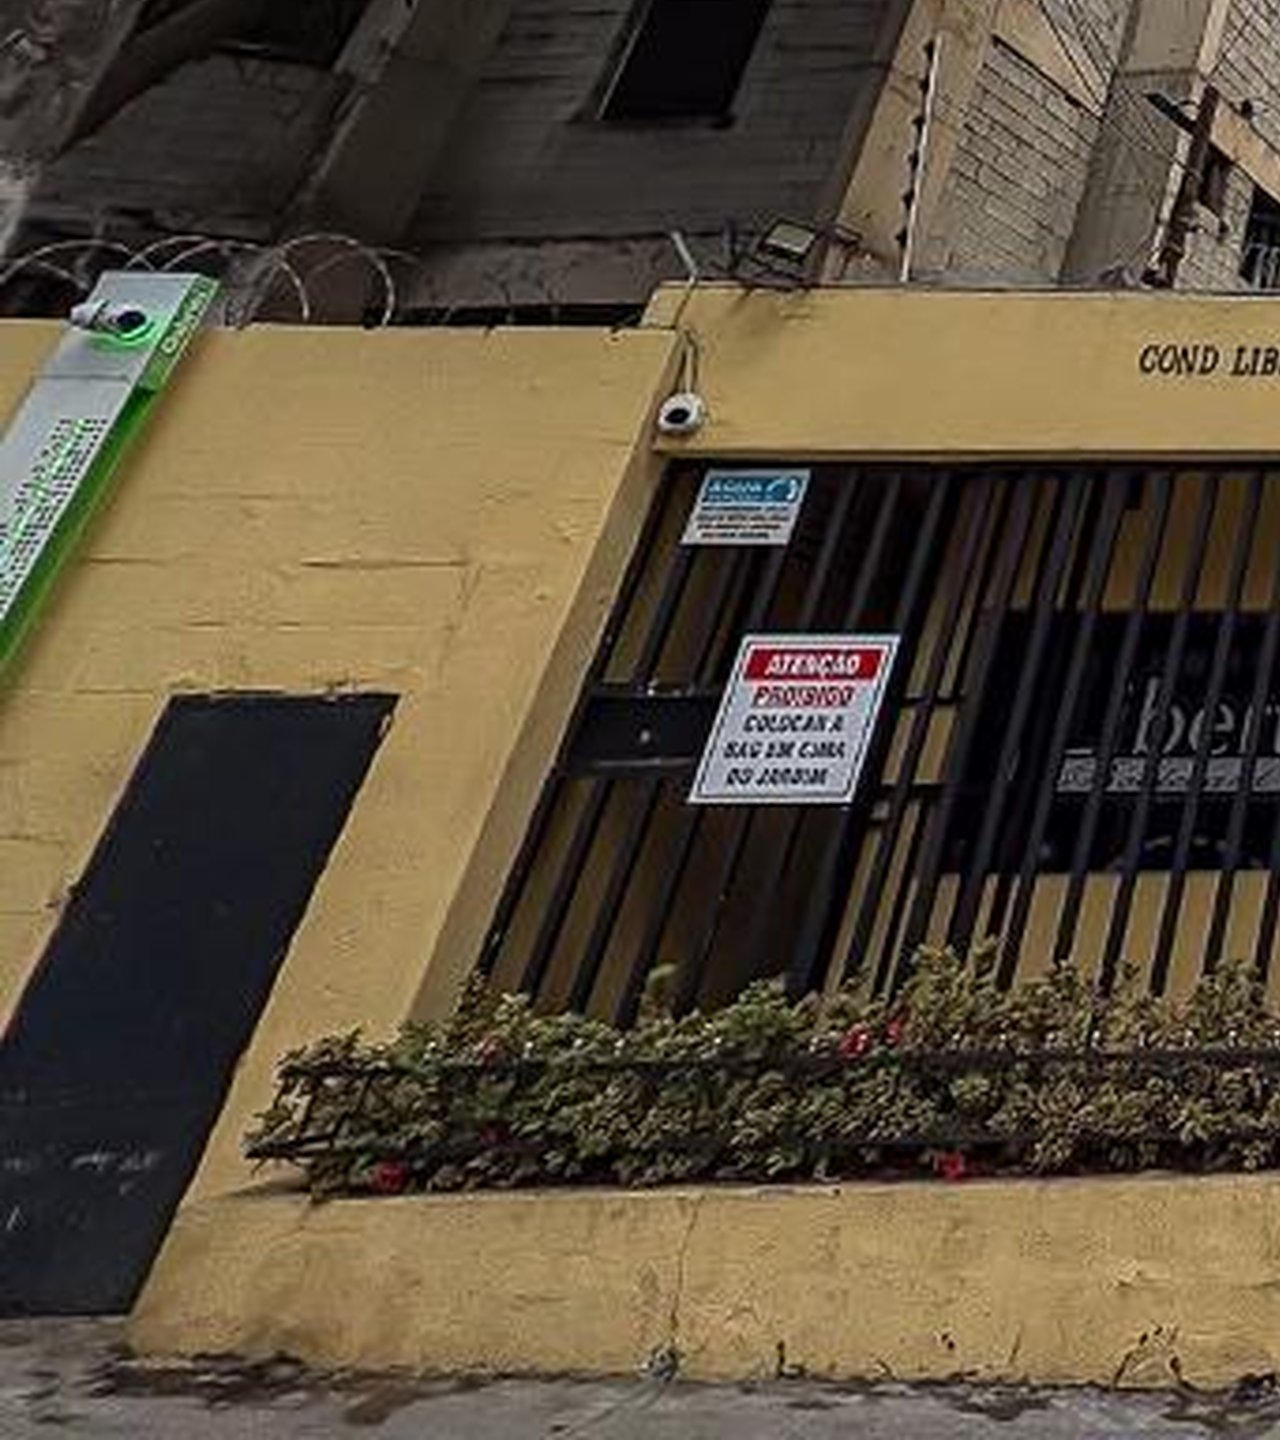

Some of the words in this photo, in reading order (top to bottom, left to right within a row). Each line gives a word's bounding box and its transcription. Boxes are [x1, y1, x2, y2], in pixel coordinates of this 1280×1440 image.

[1138, 344, 1219, 375] COND
[765, 652, 860, 678] ATENÇÃO
[753, 685, 856, 708] PROIBIDO
